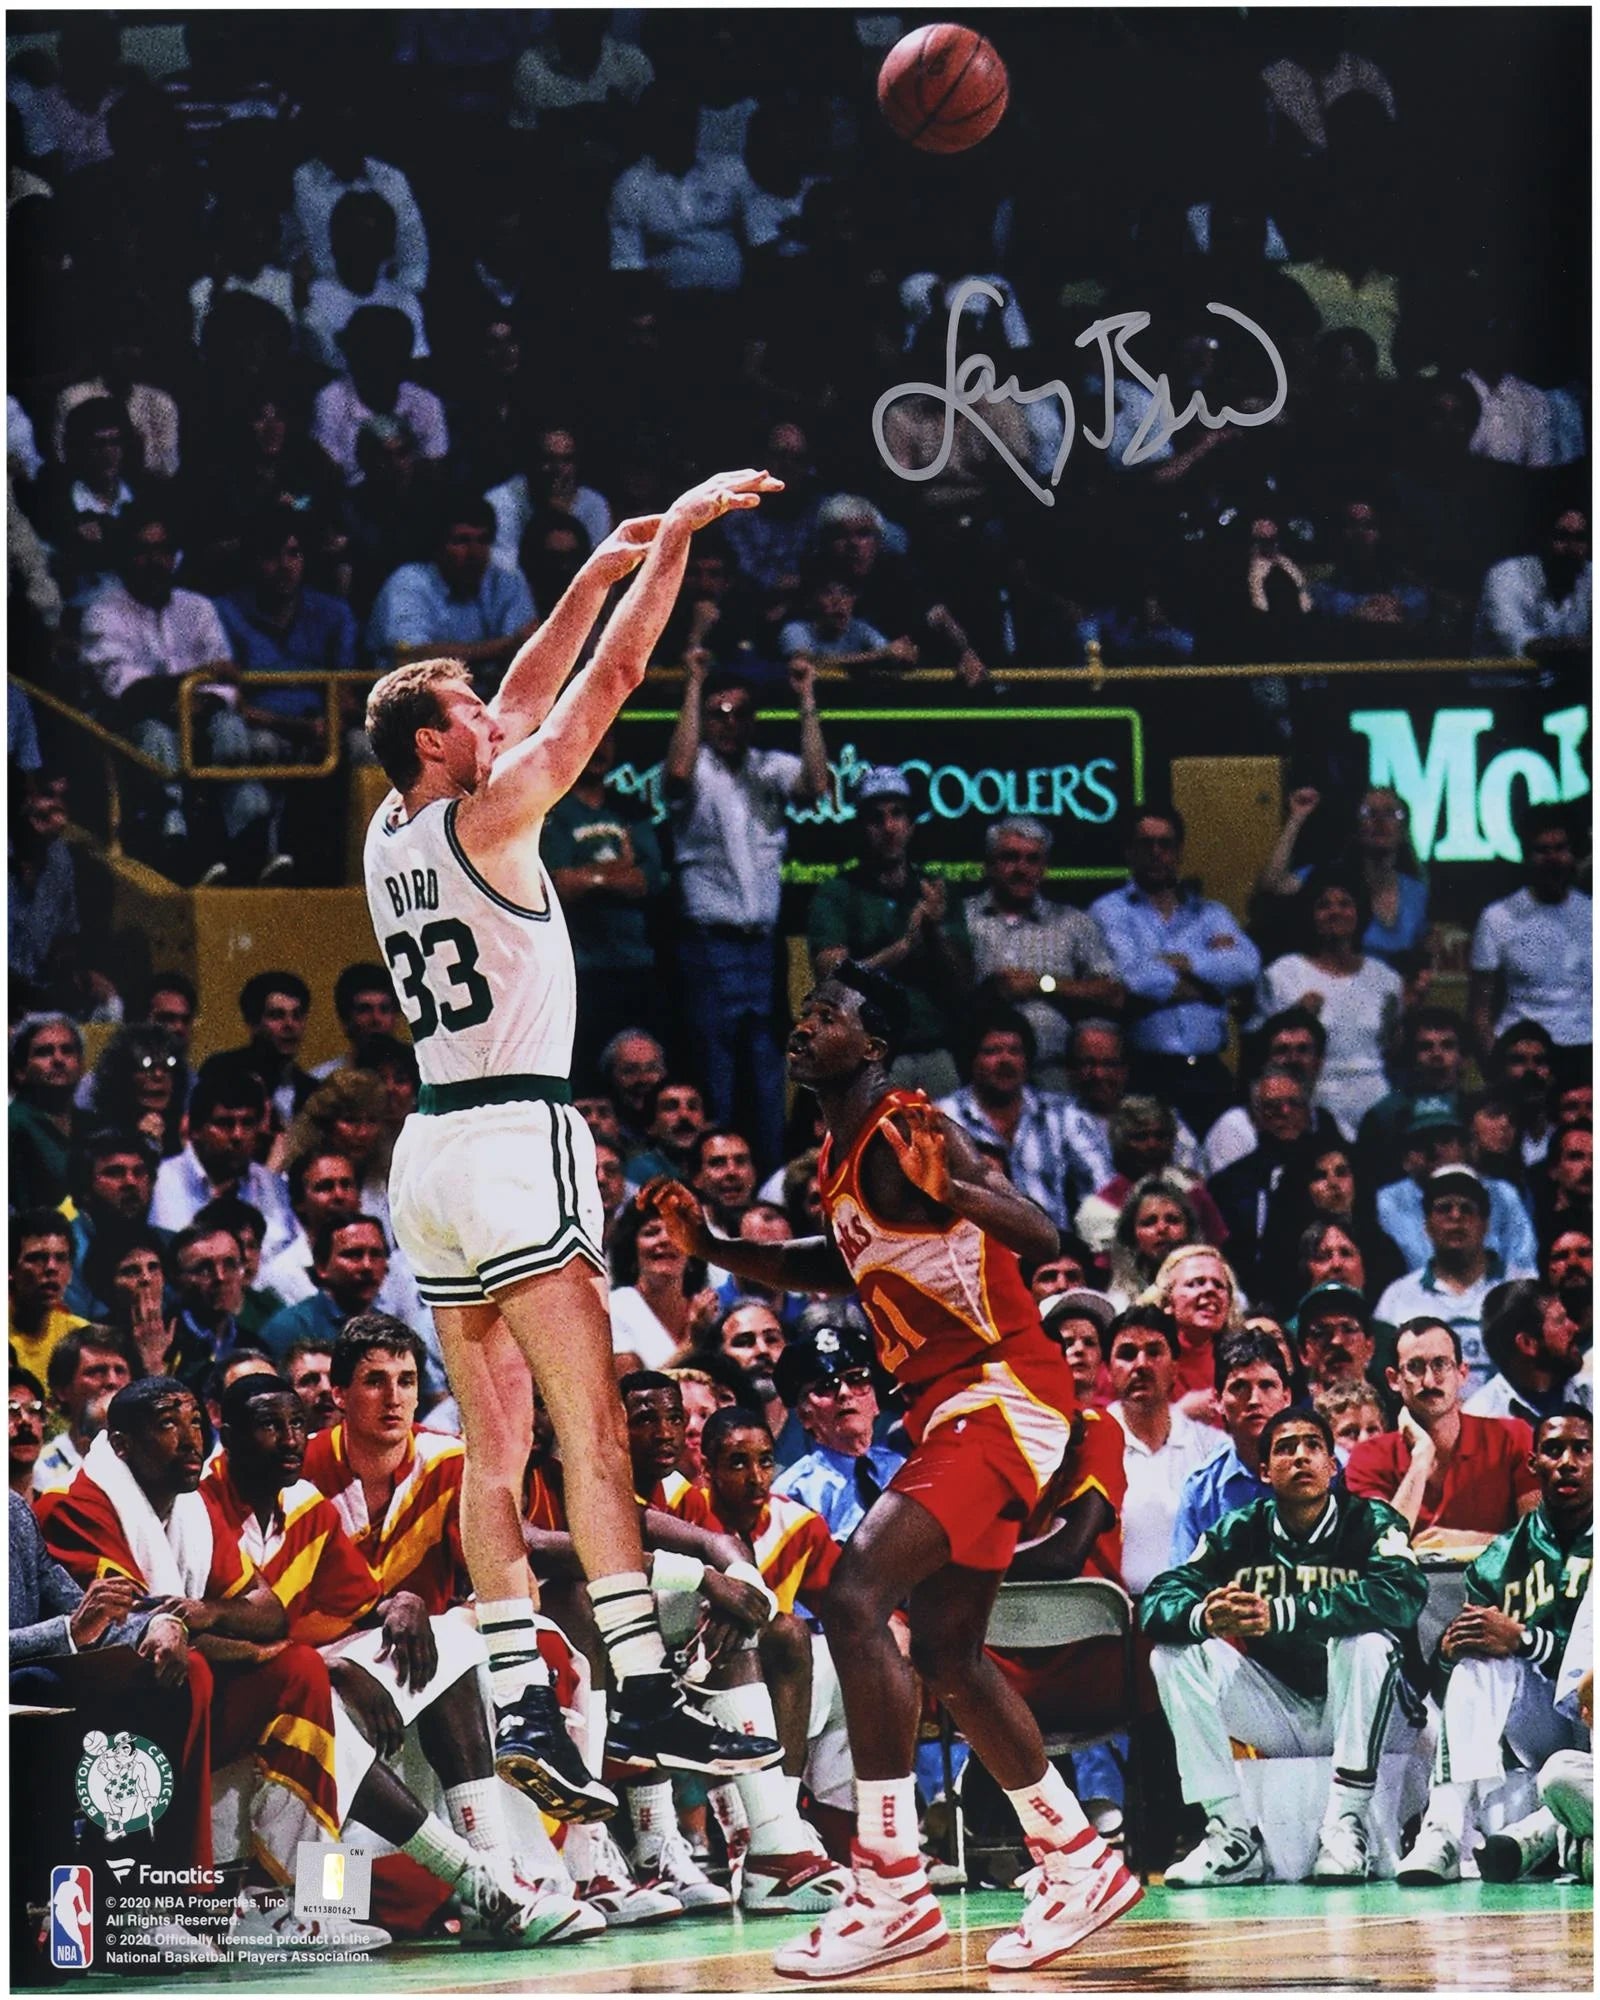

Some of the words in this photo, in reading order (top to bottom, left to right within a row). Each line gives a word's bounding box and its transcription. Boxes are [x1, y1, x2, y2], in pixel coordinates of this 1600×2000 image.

[385, 868, 439, 917] BIRD
[384, 918, 494, 1043] 33
[303, 1905, 356, 1915] NC113801621
